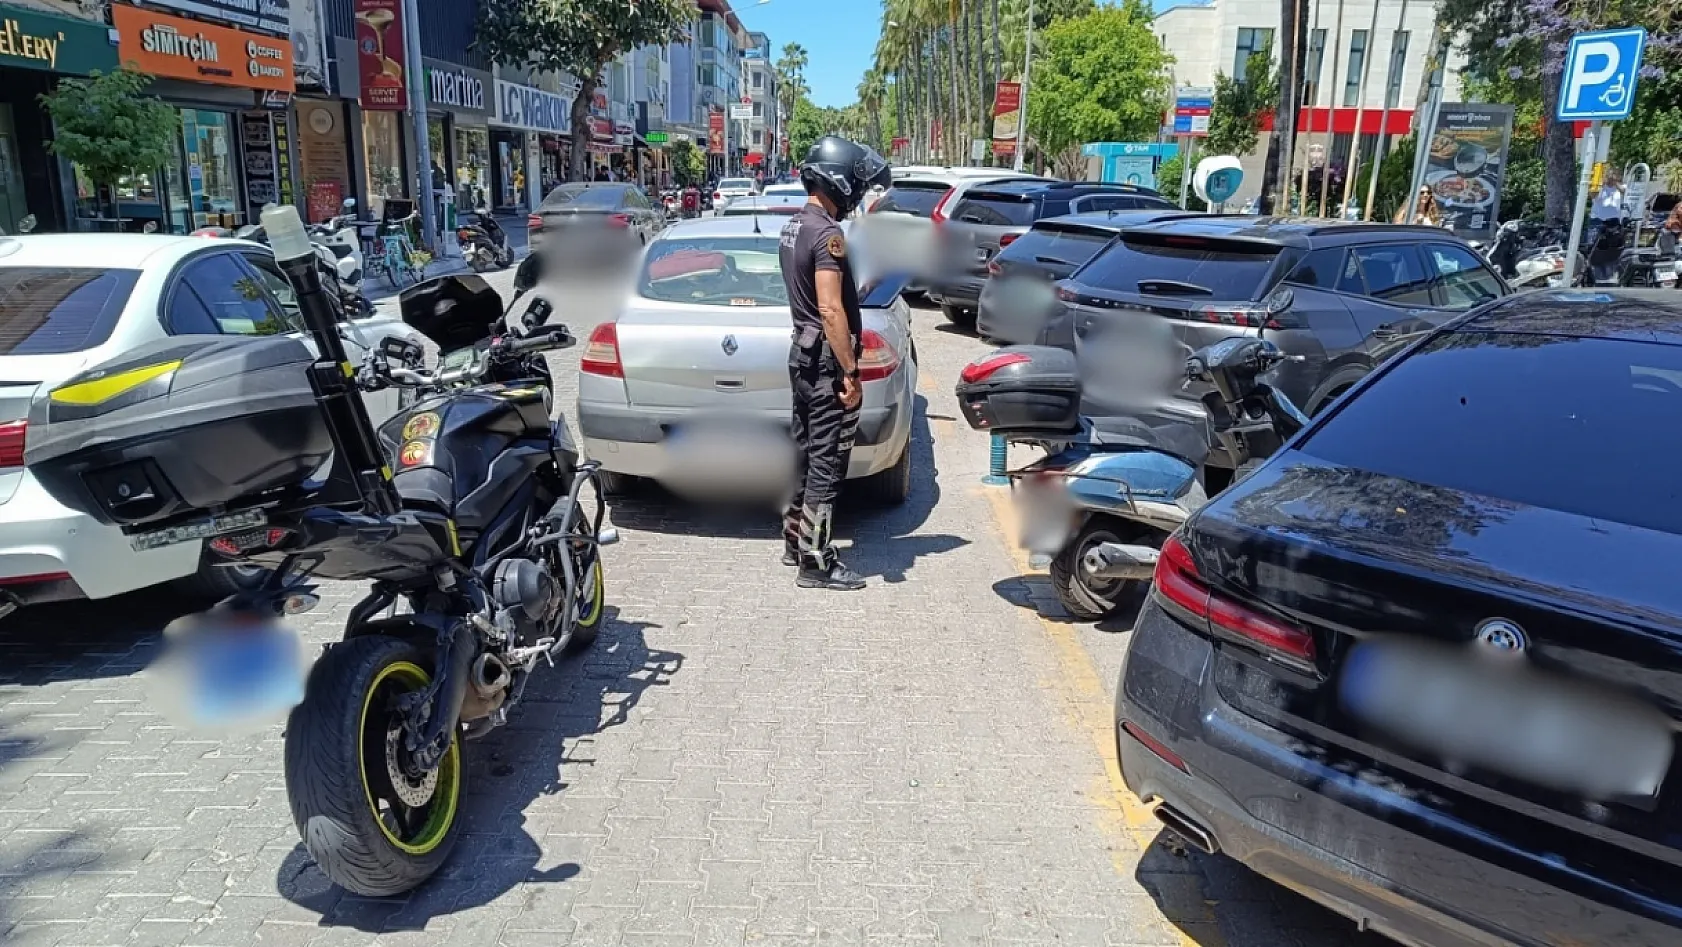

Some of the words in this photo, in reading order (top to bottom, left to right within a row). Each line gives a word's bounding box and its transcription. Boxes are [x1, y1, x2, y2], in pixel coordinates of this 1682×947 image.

[258, 46, 283, 60] COFFEE
[260, 64, 284, 78] BAKERY
[1566, 41, 1621, 109] P
[500, 83, 519, 125] LC
